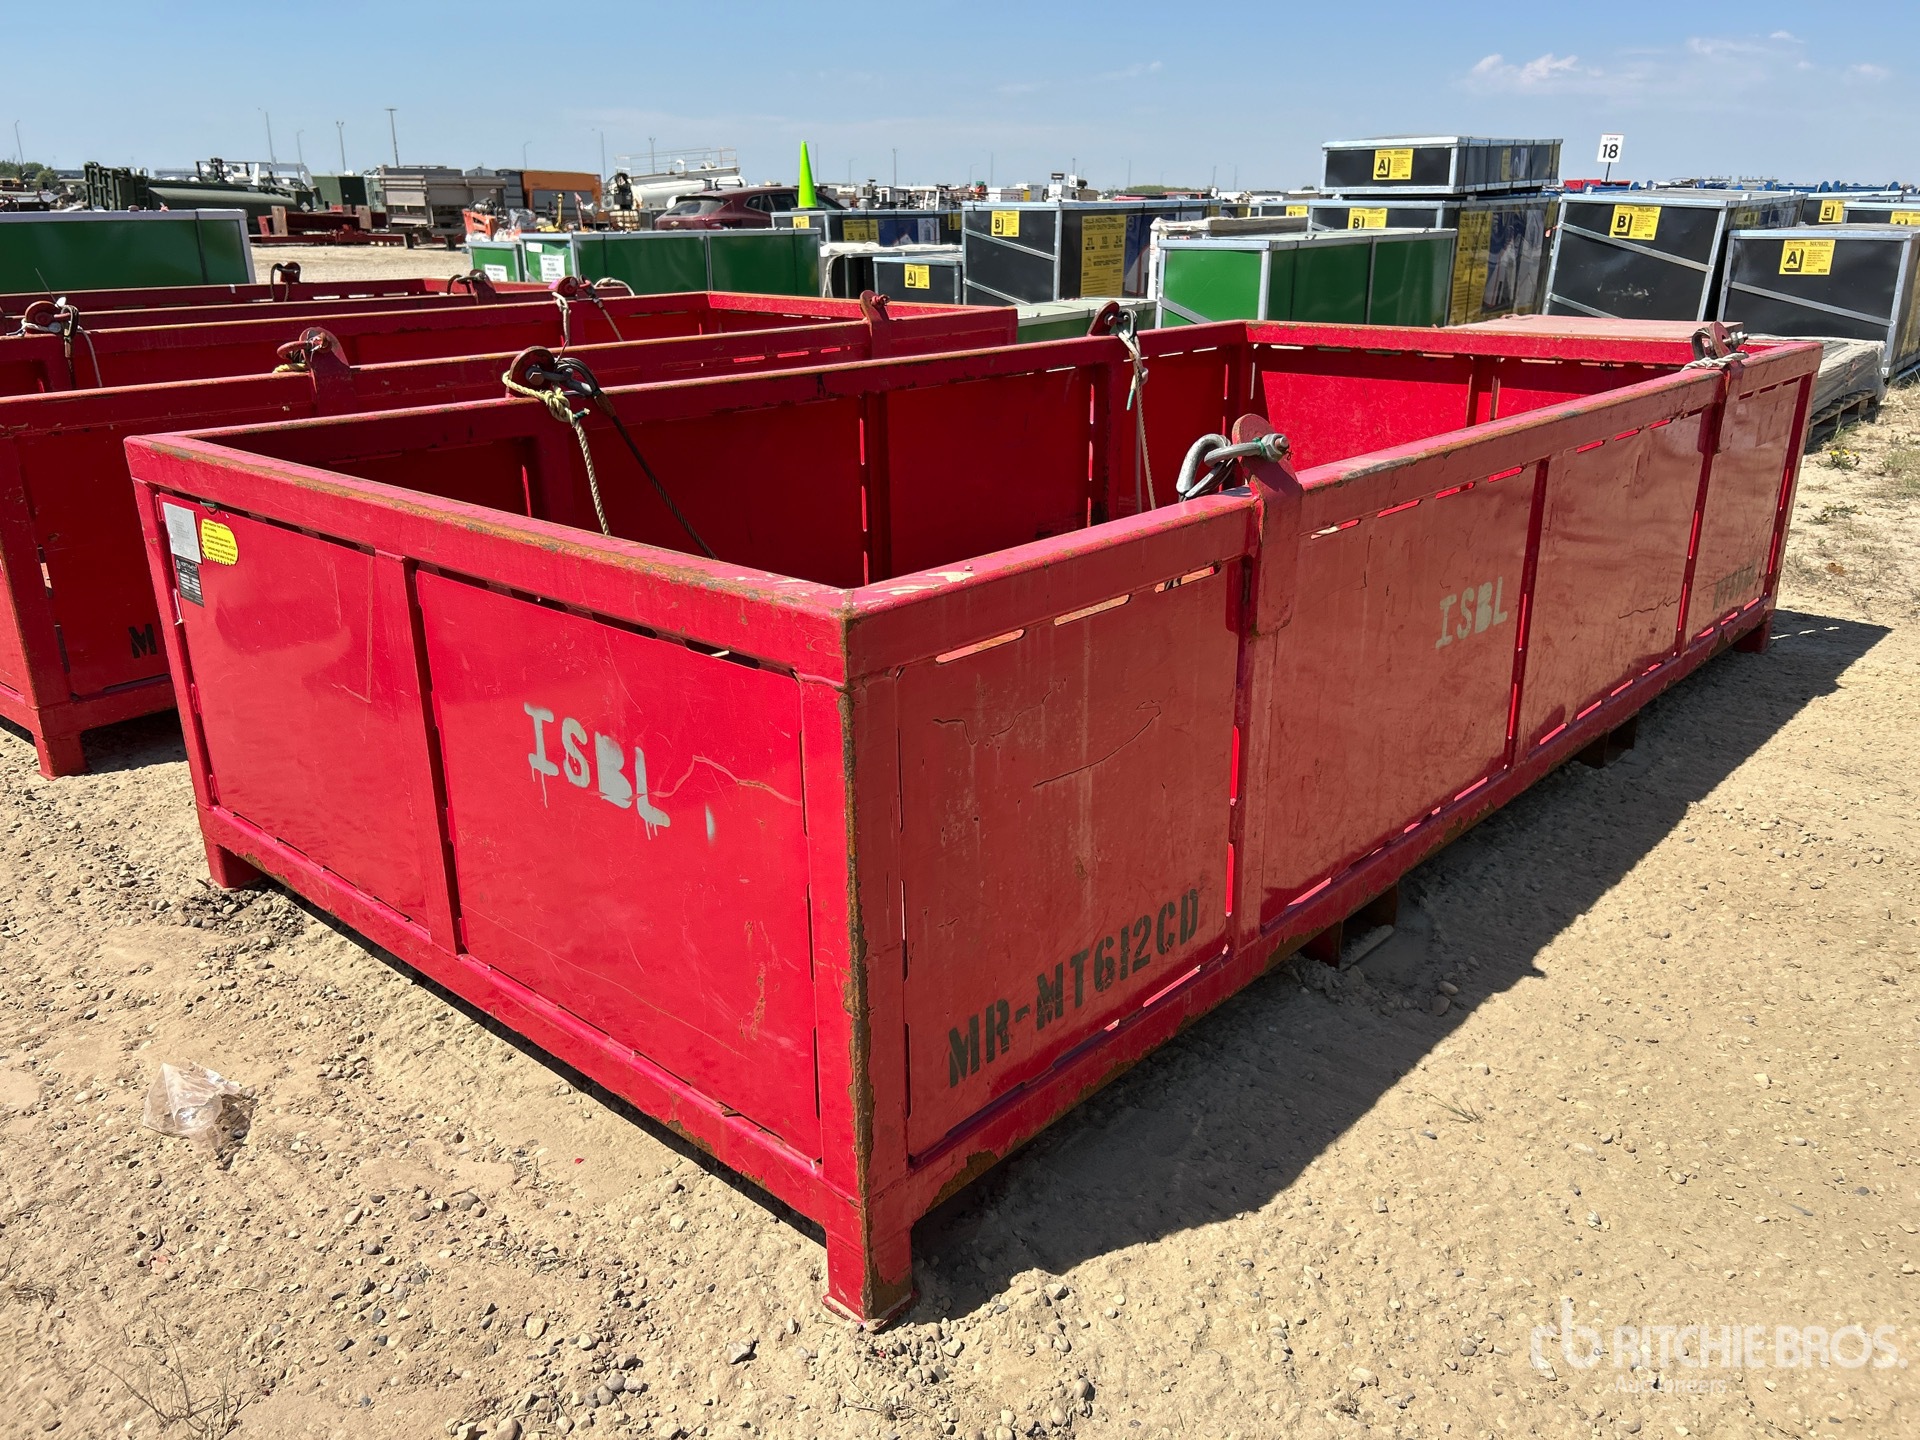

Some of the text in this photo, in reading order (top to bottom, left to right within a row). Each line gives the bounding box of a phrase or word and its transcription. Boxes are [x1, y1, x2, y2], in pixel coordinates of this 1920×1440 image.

[1602, 143, 1619, 159] 18
[1378, 159, 1386, 171] A
[1823, 207, 1832, 216] E
[995, 219, 1001, 229] B
[1352, 217, 1360, 228] B
[1616, 215, 1627, 228] B
[1785, 250, 1798, 264] A
[907, 270, 914, 281] A
[1435, 576, 1508, 649] ISBL
[523, 702, 671, 830] ISBL
[949, 888, 1198, 1088] MR-MT612CD
